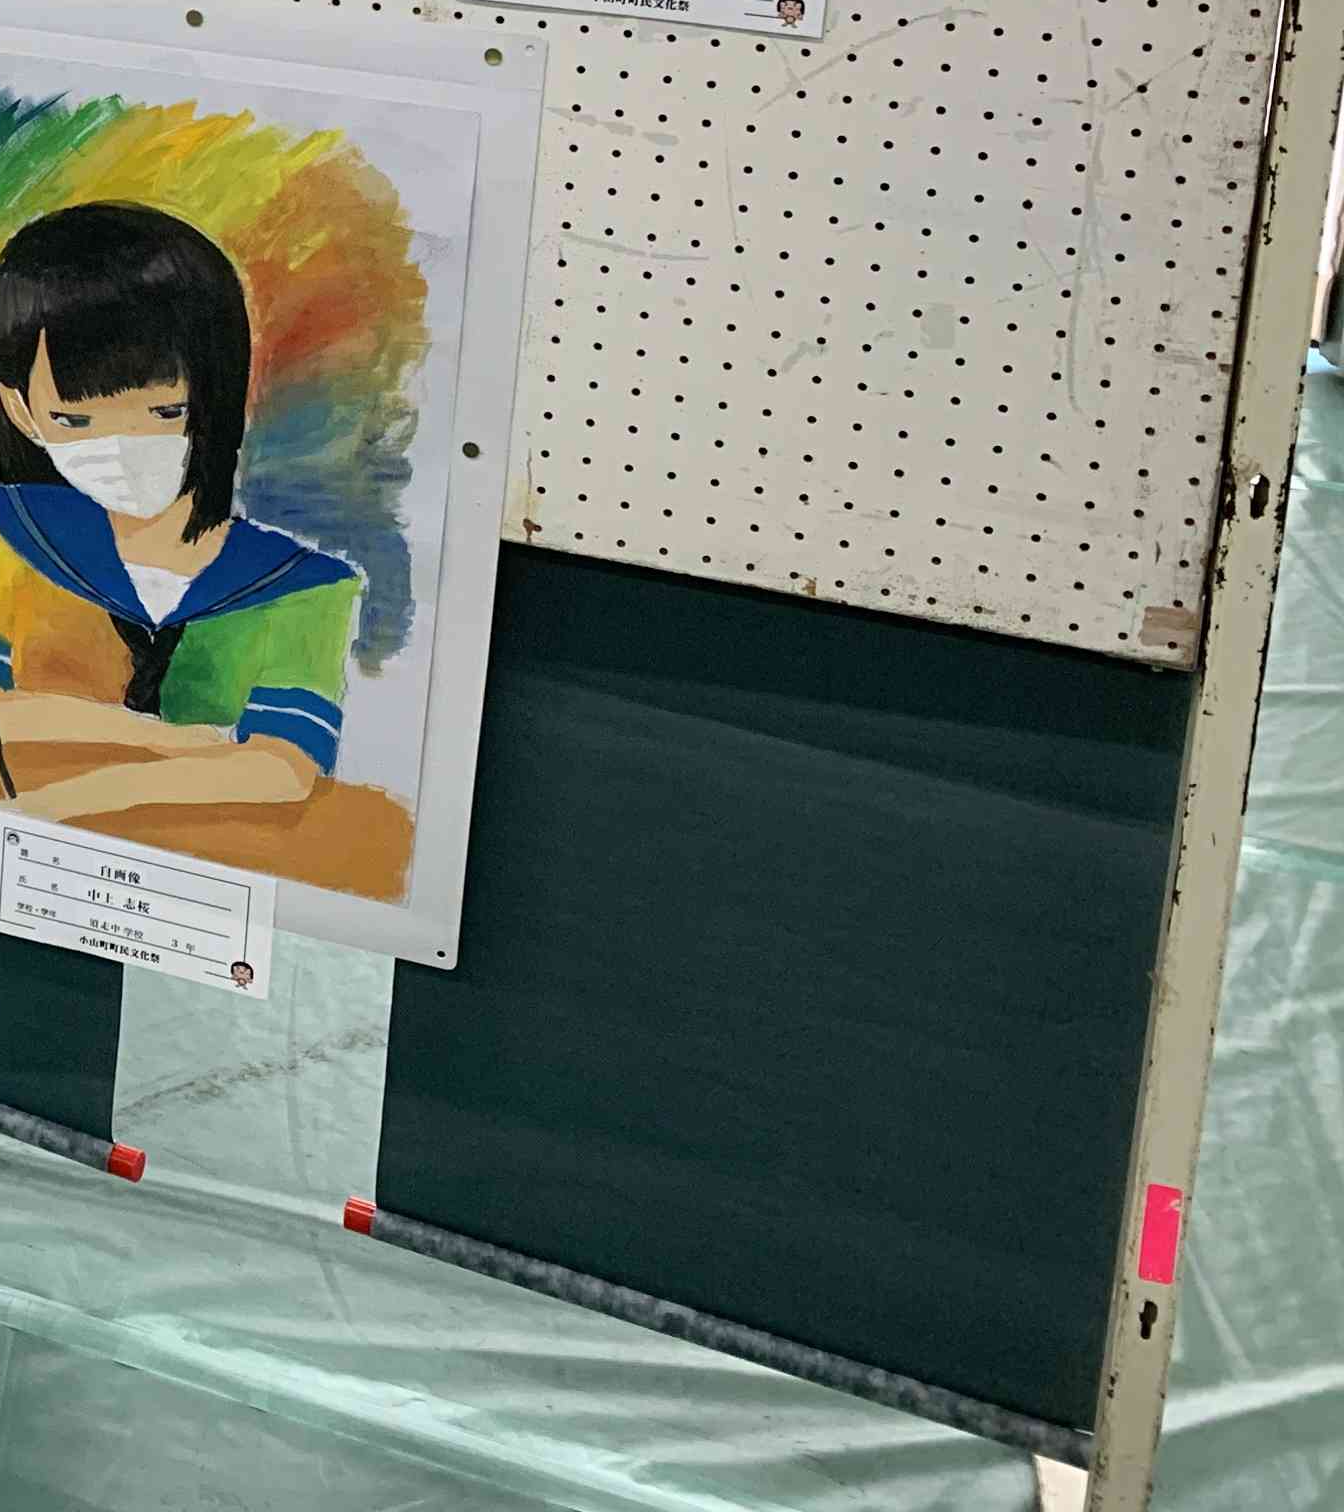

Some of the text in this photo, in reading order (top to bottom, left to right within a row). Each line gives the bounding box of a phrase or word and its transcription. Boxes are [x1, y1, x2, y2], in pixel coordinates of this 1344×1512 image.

[100, 865, 141, 885] 自画像
[79, 935, 160, 964] 小山町町民文化祭
